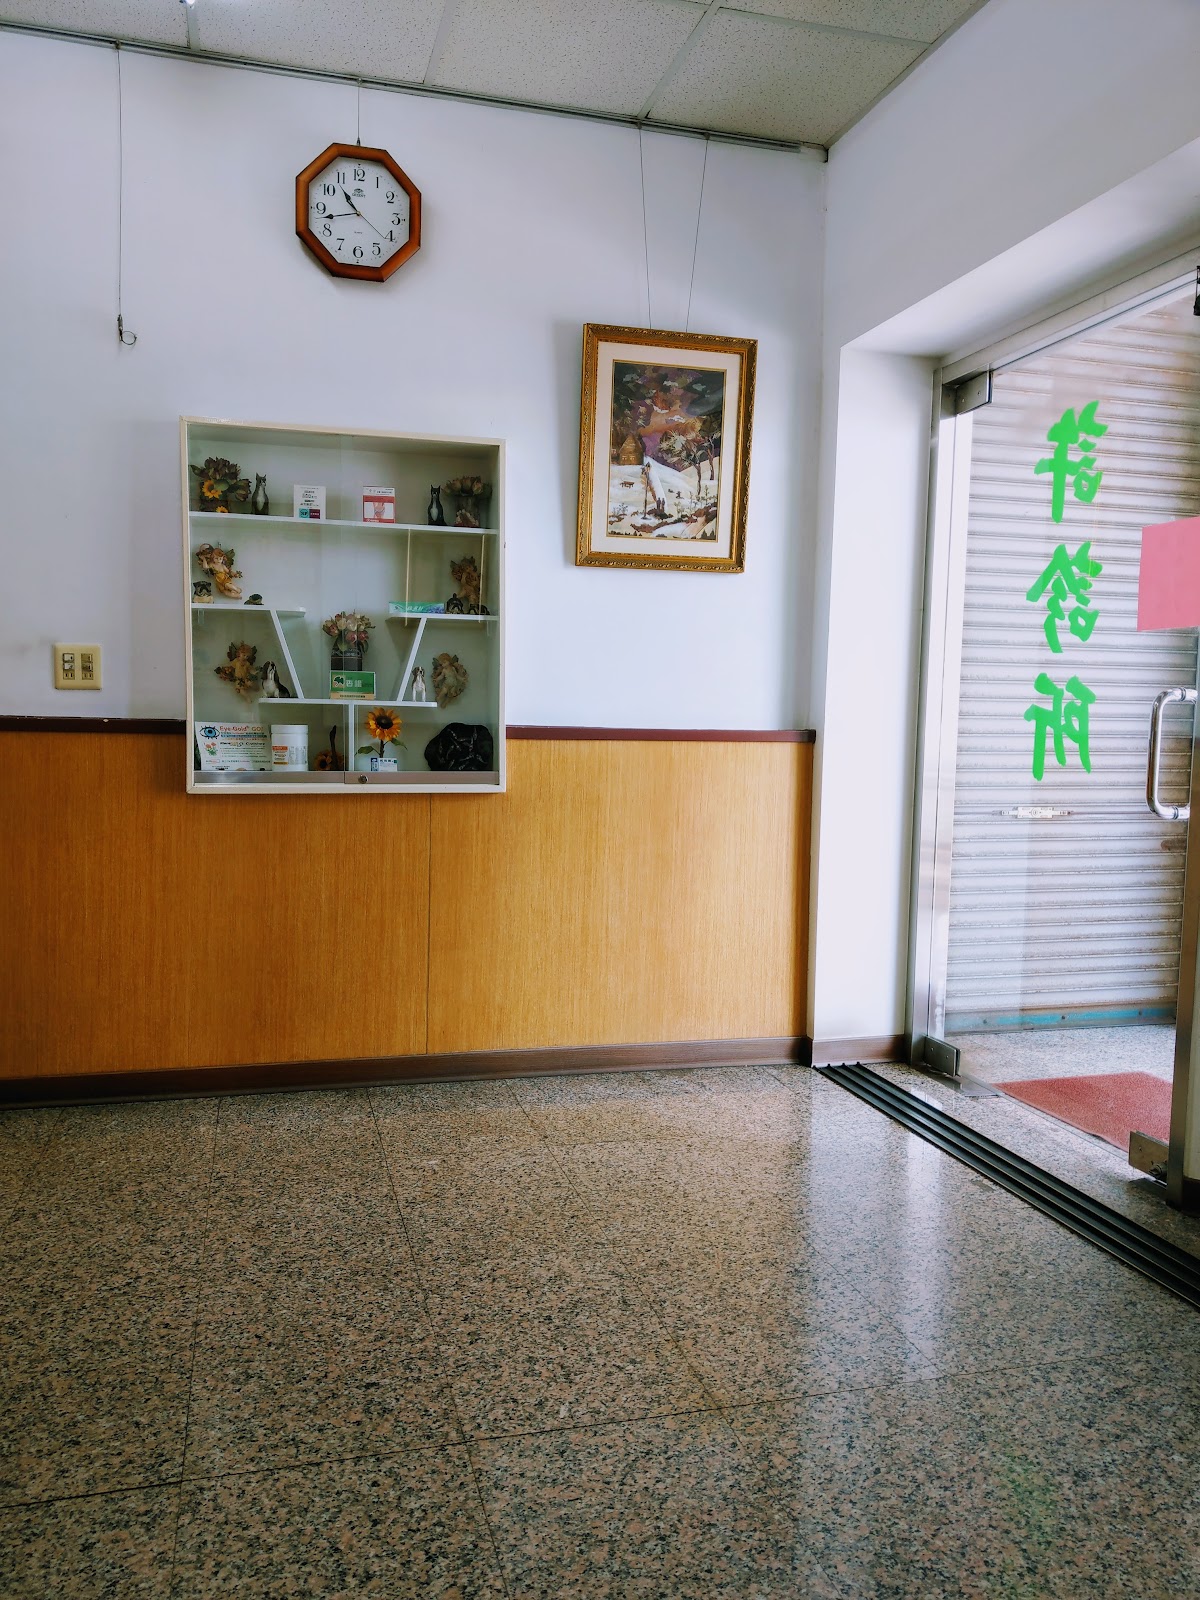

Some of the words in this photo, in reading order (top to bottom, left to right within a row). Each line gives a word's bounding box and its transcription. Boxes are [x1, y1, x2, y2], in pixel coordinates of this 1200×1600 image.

[337, 171, 346, 184] 11
[353, 168, 366, 181] 12
[376, 176, 379, 188] 1
[323, 183, 336, 196] 10
[385, 191, 395, 204] 2
[316, 202, 326, 215] 9
[391, 213, 401, 225] 3
[322, 223, 332, 237] 8
[384, 230, 396, 242] 4
[336, 238, 345, 250] 7
[371, 242, 381, 255] 5
[352, 245, 363, 258] 6
